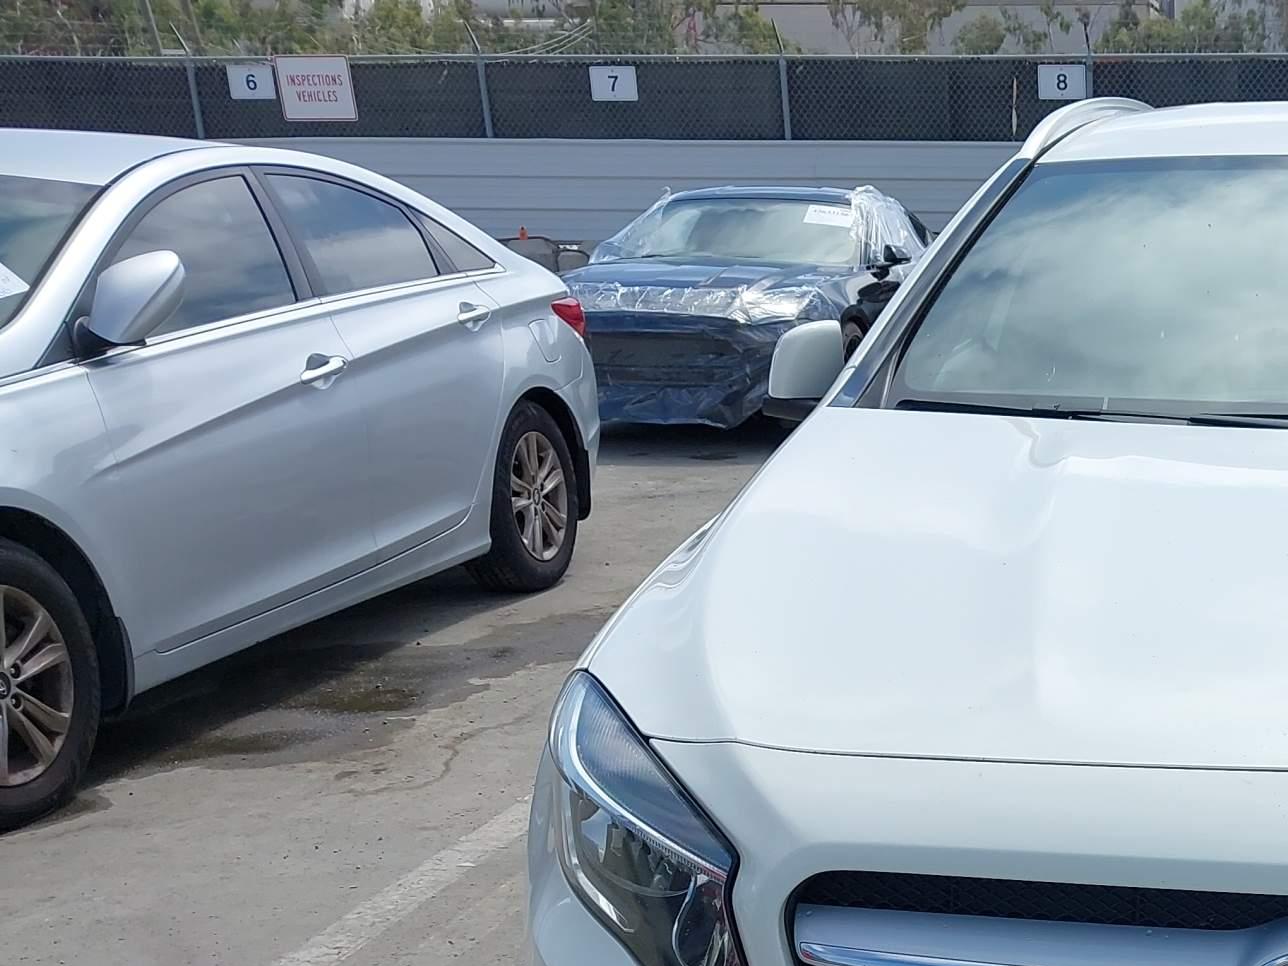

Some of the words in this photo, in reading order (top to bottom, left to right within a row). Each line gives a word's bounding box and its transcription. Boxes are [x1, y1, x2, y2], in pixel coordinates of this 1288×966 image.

[245, 74, 257, 91] 6
[286, 74, 343, 86] INSPECTIONS
[607, 75, 618, 92] 7
[1056, 73, 1068, 91] 8
[296, 90, 338, 103] VEHICLES
